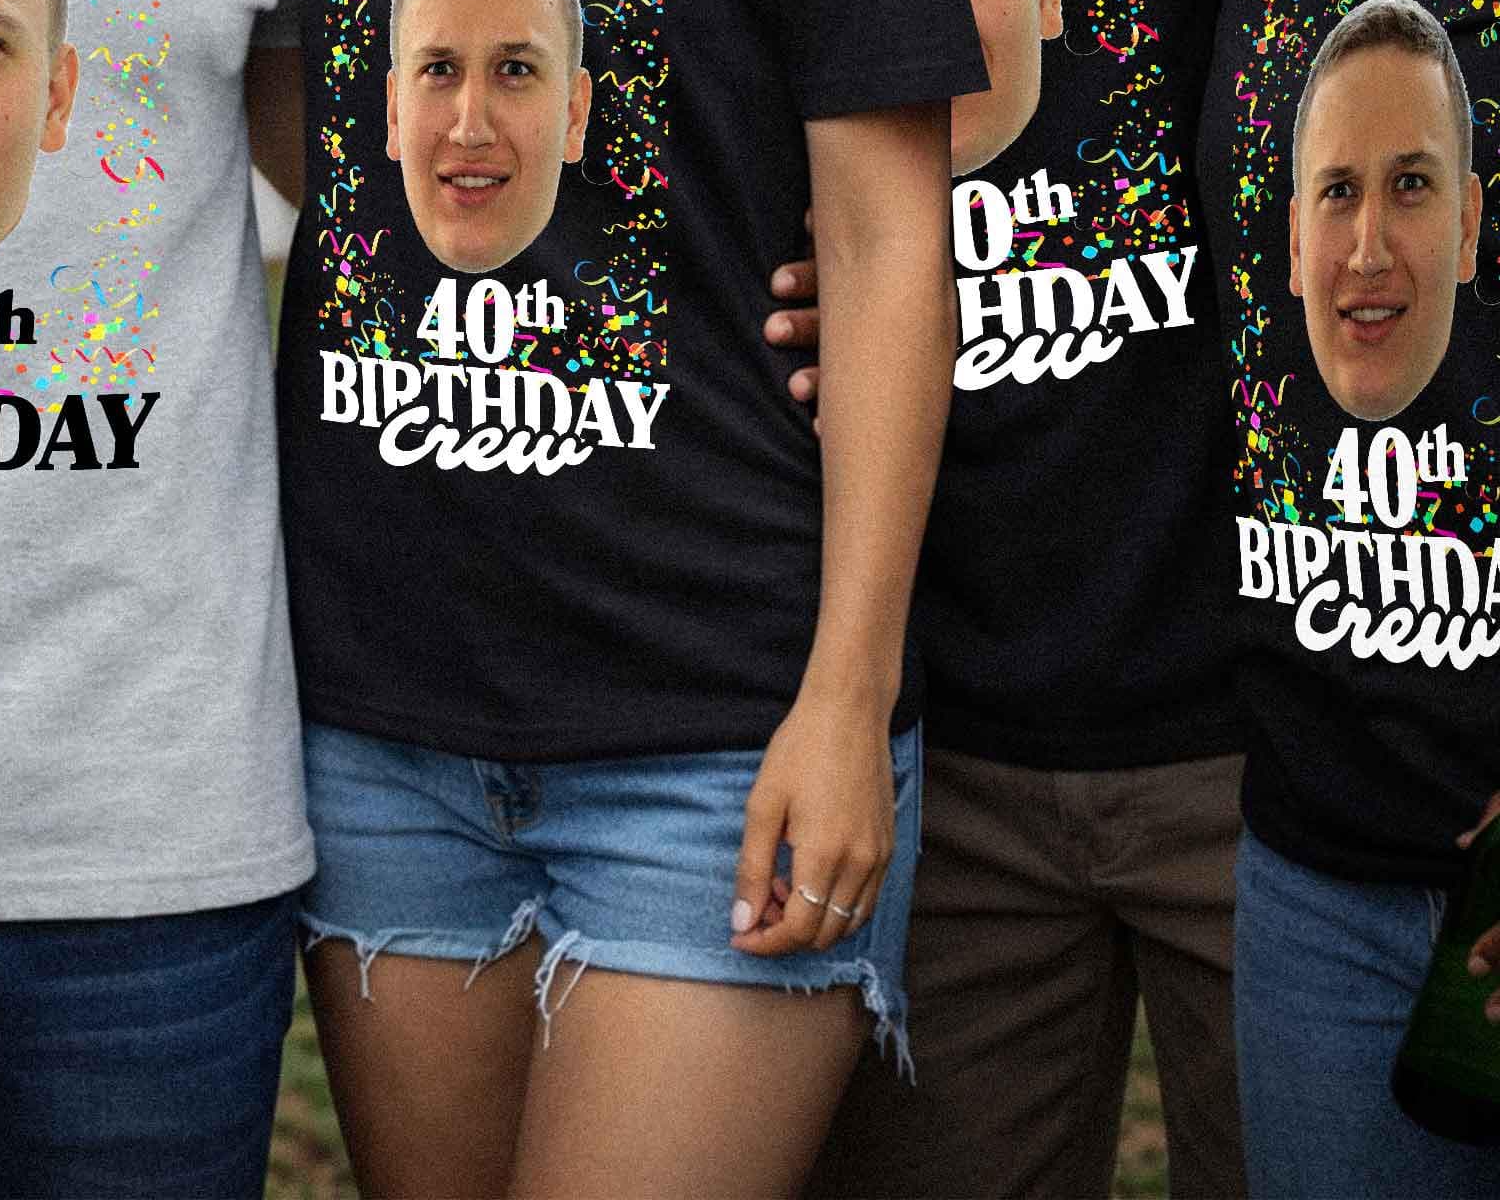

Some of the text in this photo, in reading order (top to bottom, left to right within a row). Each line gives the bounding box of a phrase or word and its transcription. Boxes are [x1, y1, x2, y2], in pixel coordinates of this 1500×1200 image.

[952, 168, 1078, 271] 0th
[417, 278, 567, 363] 40th
[956, 244, 1198, 345] HDAY
[320, 350, 671, 450] BIRTHDAY
[379, 405, 594, 477] Crew
[1323, 423, 1468, 528] 40th
[1236, 516, 1500, 618] BIRTHD
[1295, 579, 1500, 671] Crew
